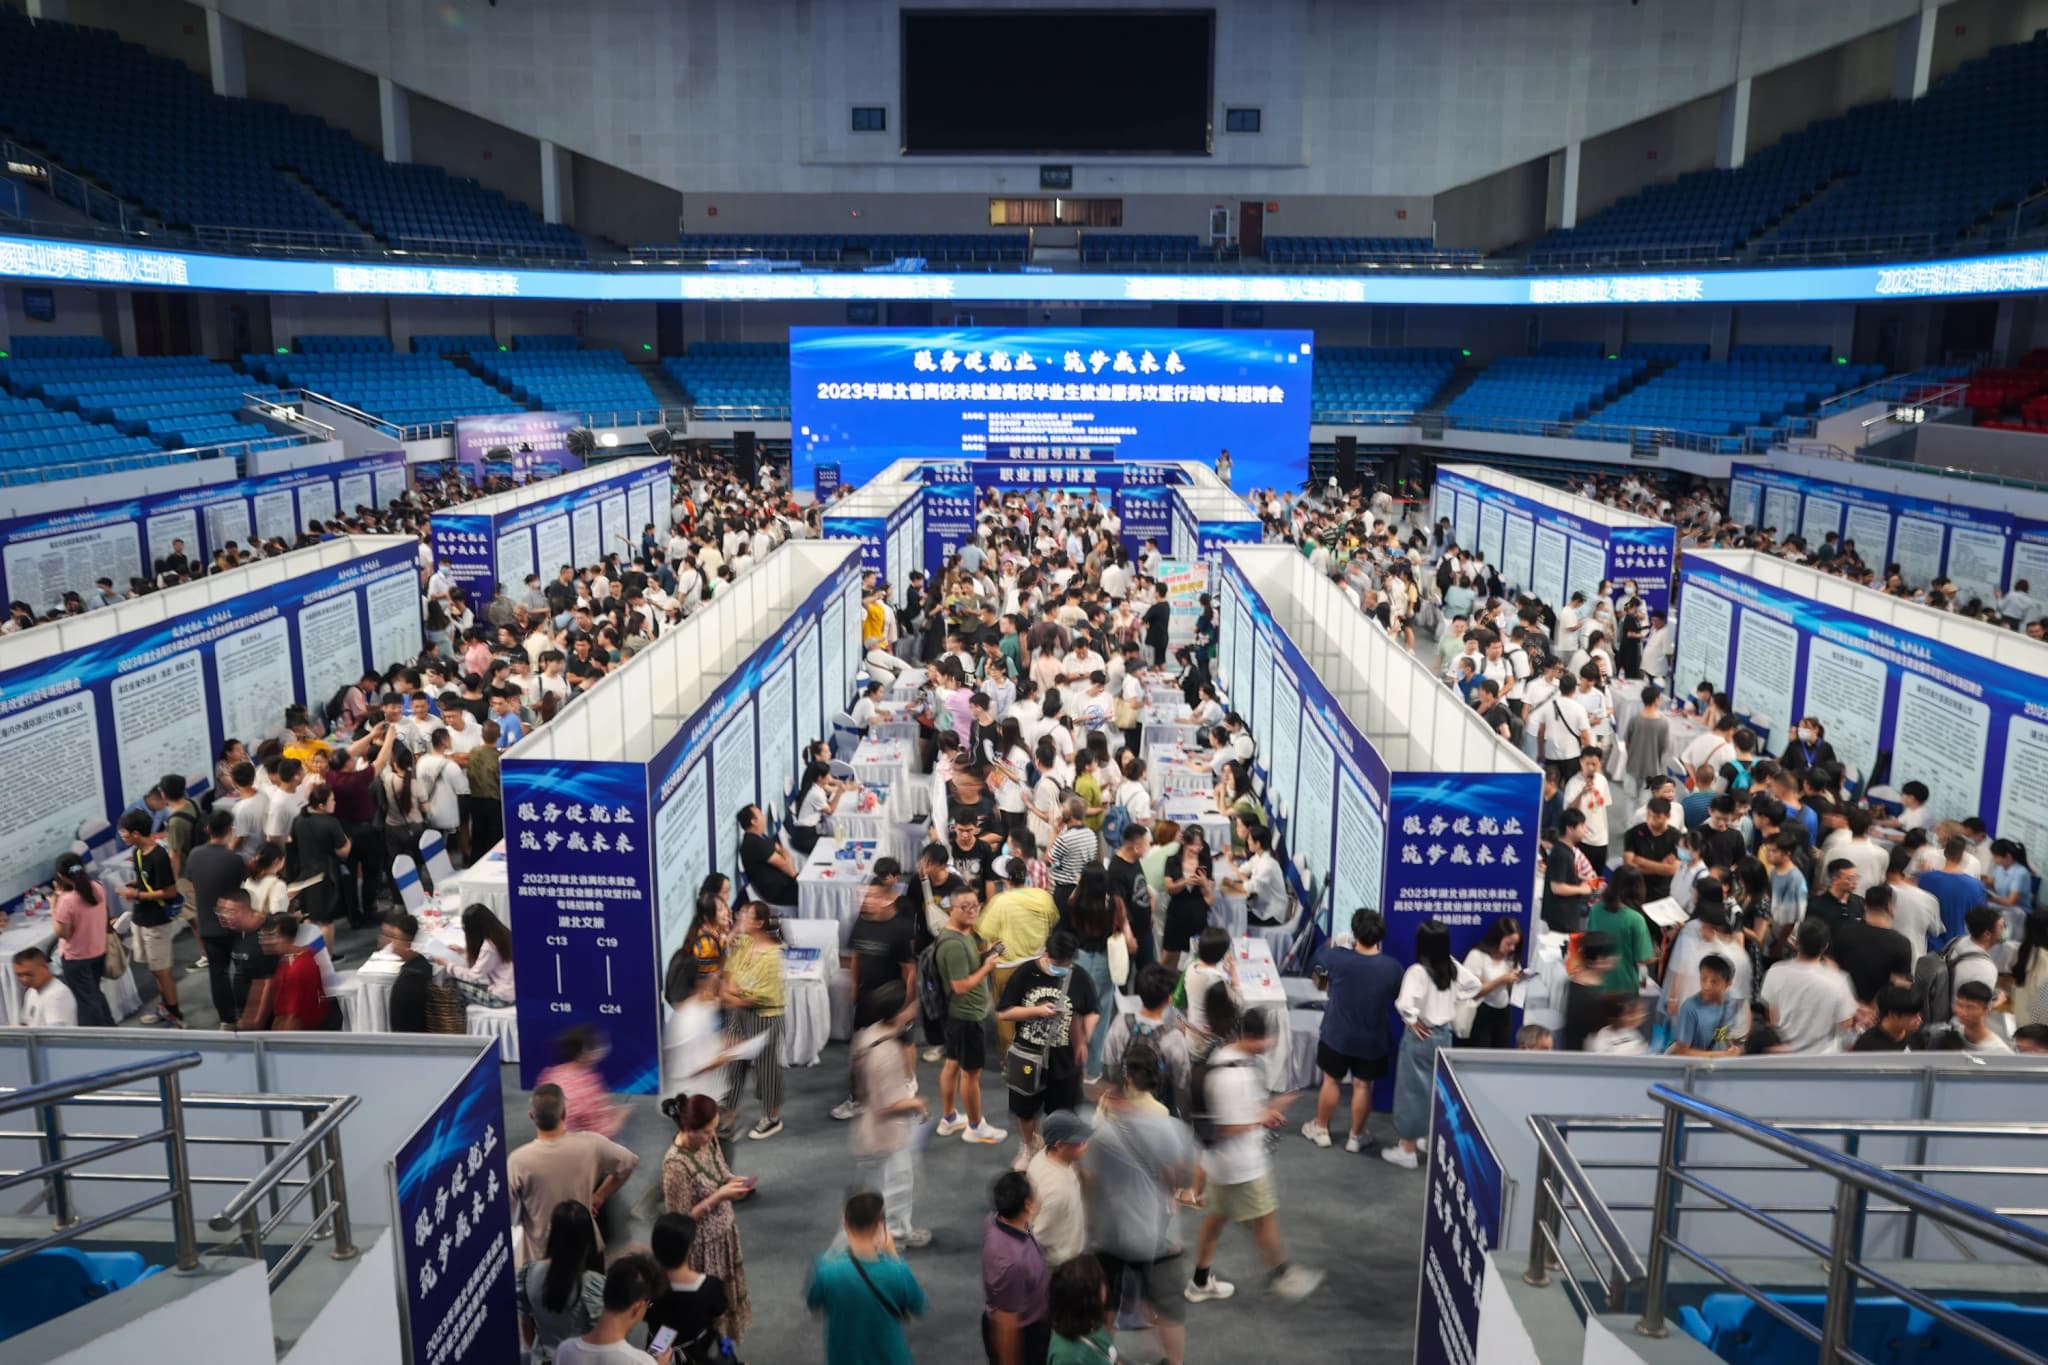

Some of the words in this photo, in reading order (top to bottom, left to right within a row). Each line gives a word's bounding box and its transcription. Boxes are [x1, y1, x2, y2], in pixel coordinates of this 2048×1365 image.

[1009, 446, 1092, 460] 职业指导讲堂
[999, 467, 1097, 483] 职业指导讲堂
[517, 801, 635, 825] 服务促就业
[1402, 814, 1525, 836] 服务促就业
[519, 829, 636, 854] 筑梦赢未来
[1401, 844, 1520, 866] 筑梦赢未来
[522, 873, 637, 887] 2023年湖北省高校未就业
[518, 885, 642, 900] 高校毕业生就业服务攻坚行动
[556, 899, 605, 912] 专场招聘会
[546, 935, 568, 946] C13
[596, 937, 619, 948] C19
[550, 1002, 572, 1013] C18
[599, 1003, 623, 1015] C24
[414, 1123, 498, 1247] 服务促就业
[418, 1168, 500, 1300] 筑梦赢未来
